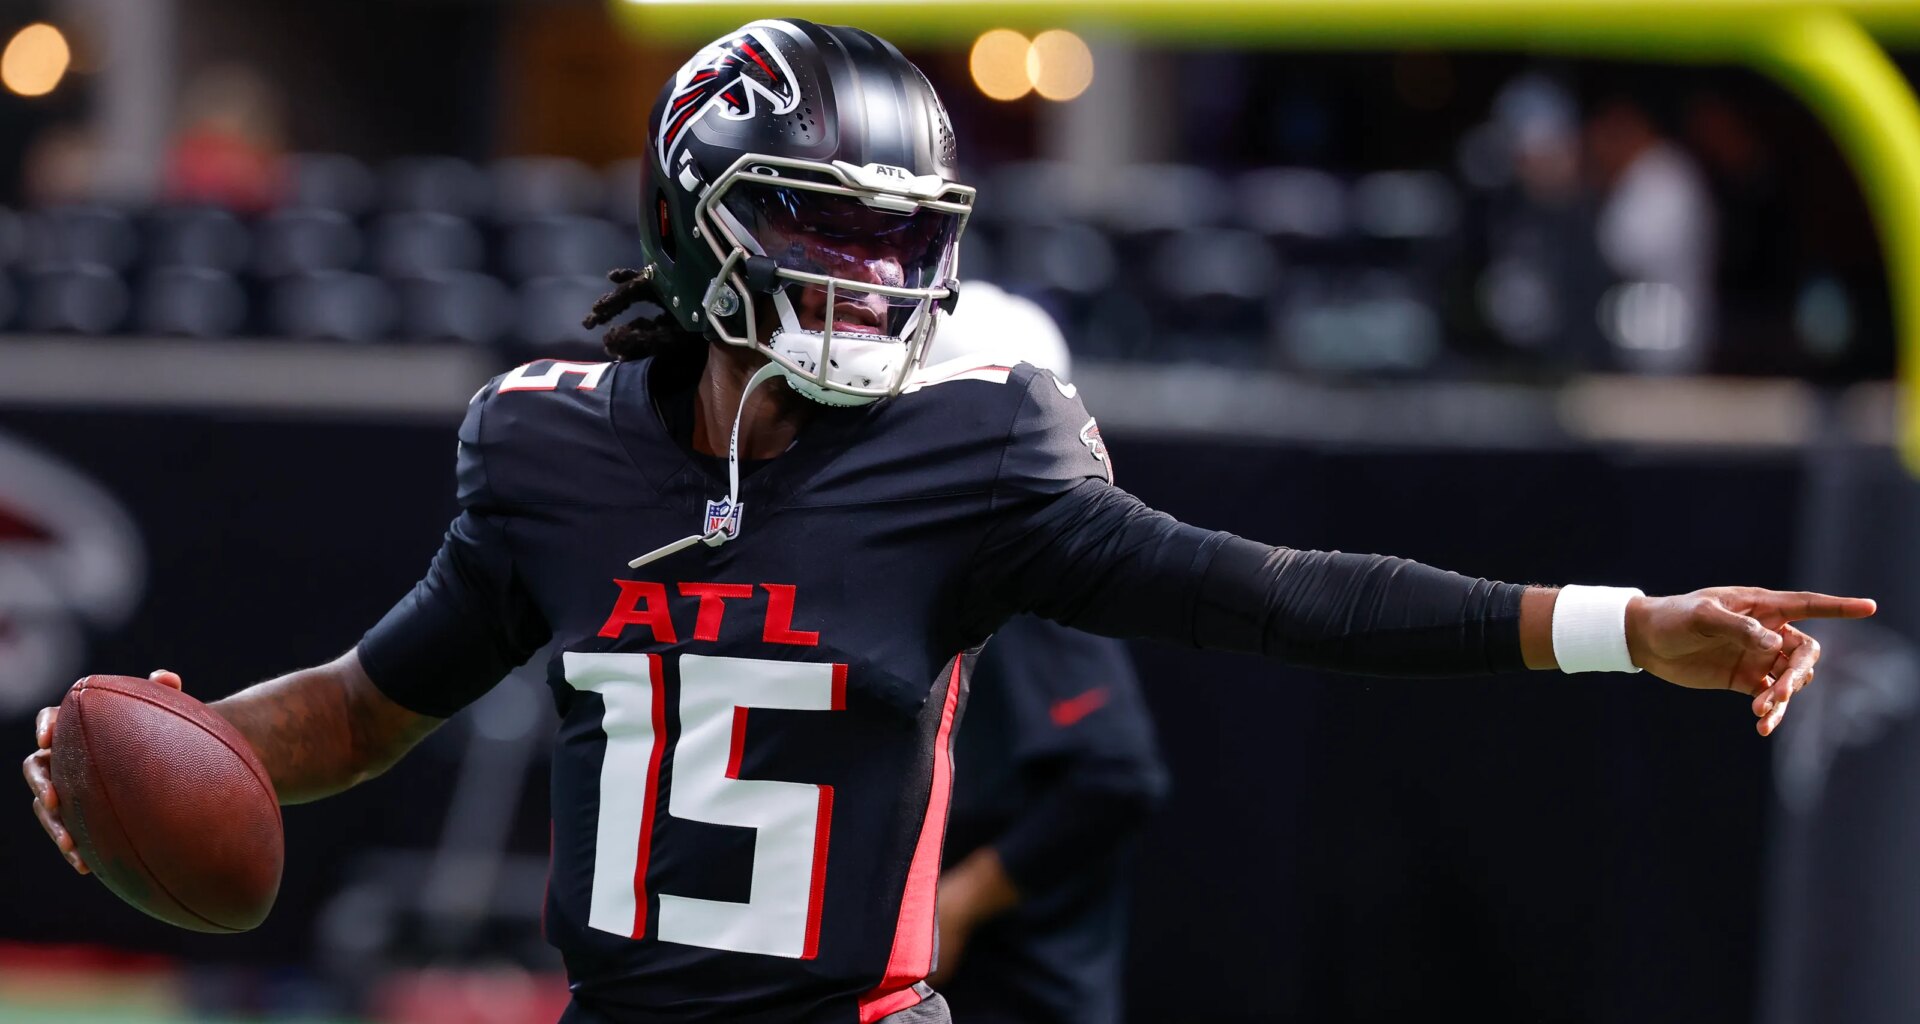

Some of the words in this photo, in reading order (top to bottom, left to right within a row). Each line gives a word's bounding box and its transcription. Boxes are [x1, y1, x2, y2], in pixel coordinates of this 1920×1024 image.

[876, 165, 906, 180] ATL
[597, 578, 820, 646] ATL
[562, 651, 849, 961] 15
